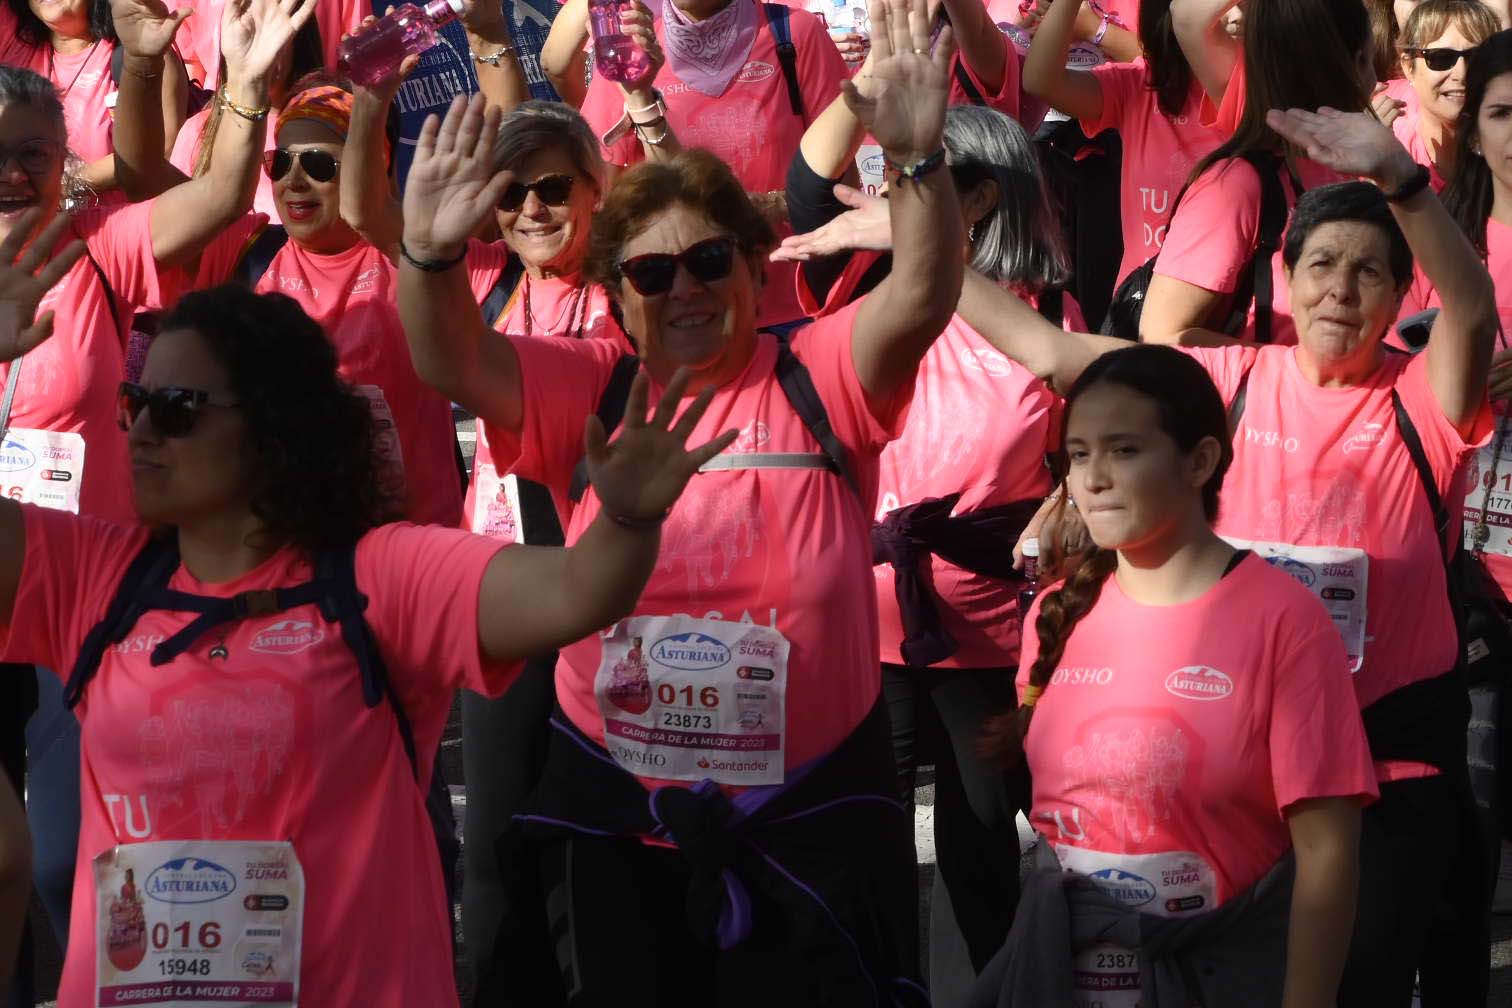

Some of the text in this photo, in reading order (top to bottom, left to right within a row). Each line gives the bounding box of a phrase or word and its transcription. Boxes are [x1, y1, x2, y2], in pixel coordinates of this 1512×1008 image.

[1139, 187, 1168, 214] TU
[1487, 514, 1499, 523] DE
[1500, 516, 1511, 525] LA
[657, 644, 725, 663] ASTURIANA
[1168, 676, 1229, 696] ASTURIANA
[657, 683, 720, 708] 016
[663, 712, 712, 730] 23873
[621, 726, 666, 744] CARRERA
[668, 733, 682, 743] DE
[684, 734, 698, 744] LA
[700, 735, 738, 748] MUJER
[711, 759, 769, 773] Santander
[102, 795, 151, 838] TU
[246, 869, 288, 880] SUMA
[1163, 874, 1200, 887] SUMA
[153, 875, 228, 893] ASTURIANA
[152, 921, 222, 949] 016
[159, 958, 211, 976] 15948
[116, 986, 161, 1001] CARRERA
[175, 986, 192, 997] LA
[195, 985, 241, 998] MUJER
[245, 986, 276, 998] 2023
